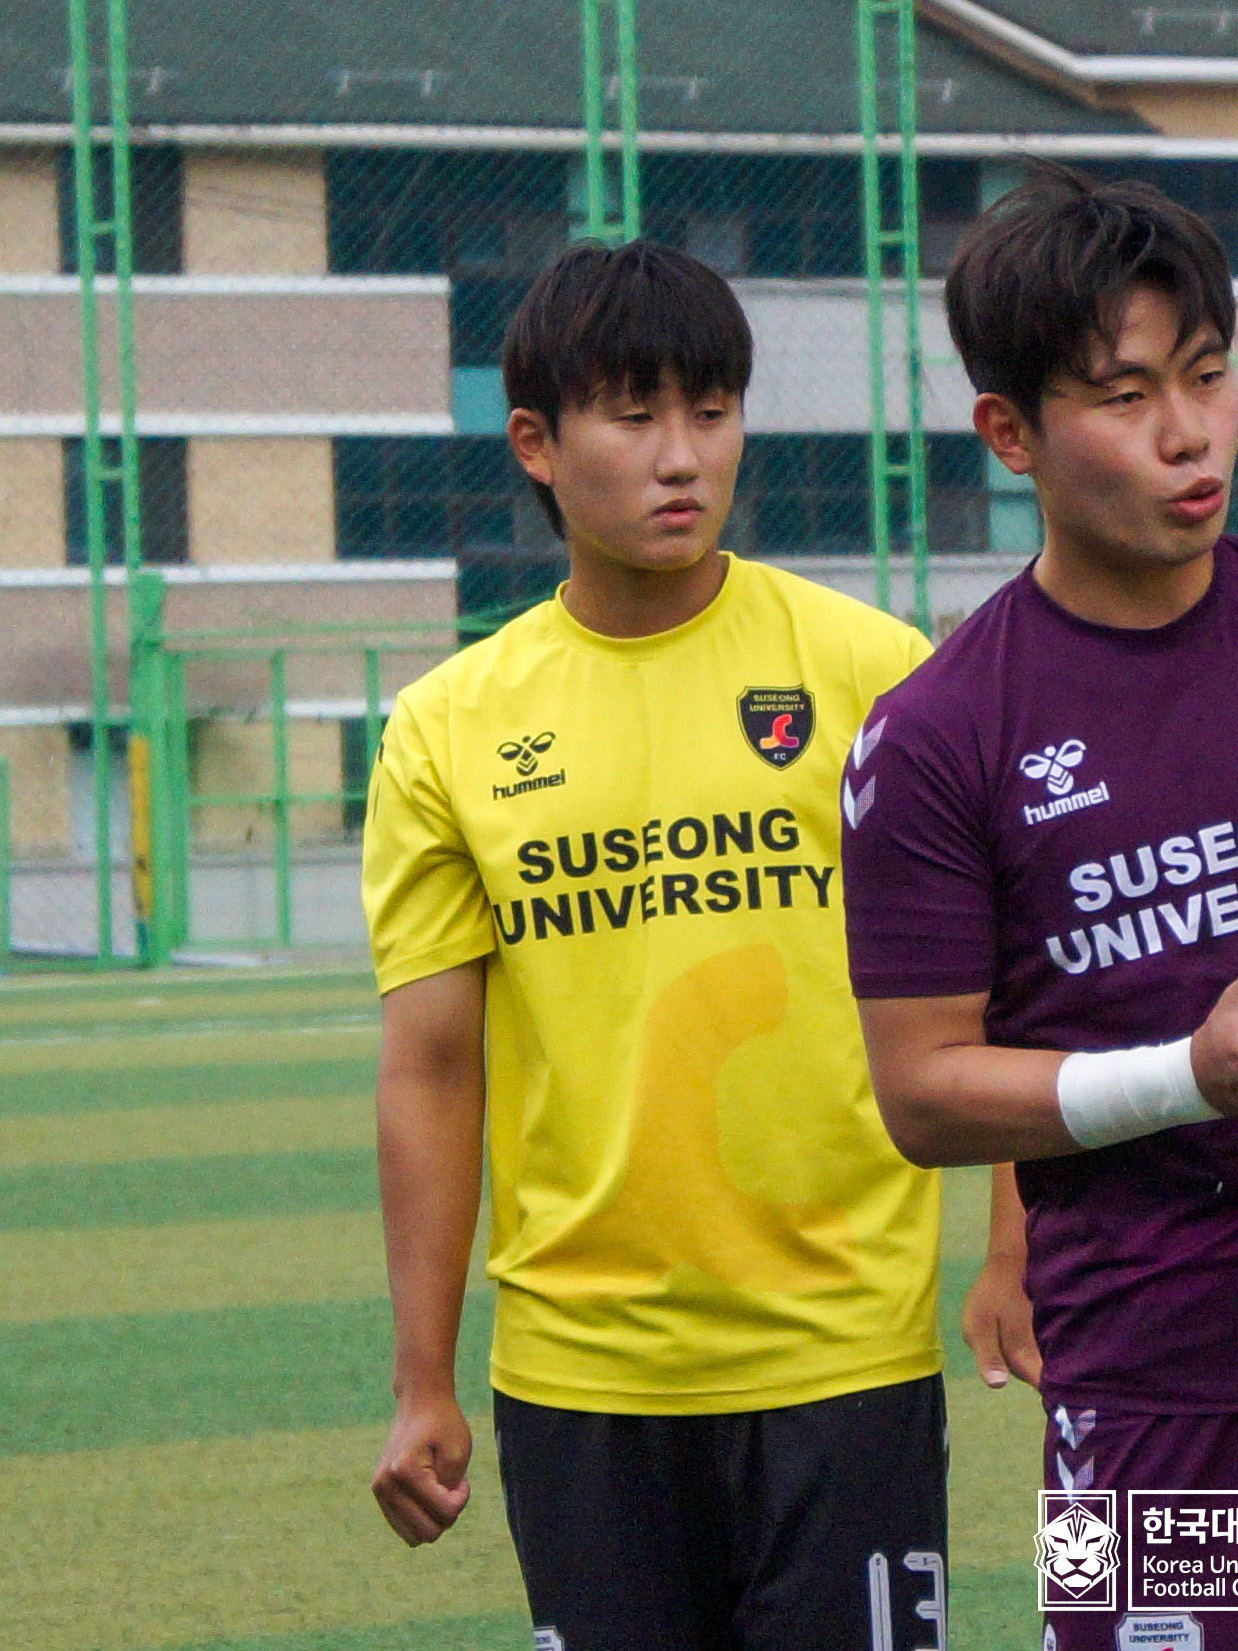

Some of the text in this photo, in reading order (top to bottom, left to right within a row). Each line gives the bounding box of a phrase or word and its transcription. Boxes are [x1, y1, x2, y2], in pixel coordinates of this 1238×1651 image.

[492, 768, 566, 800] hummel
[1023, 781, 1110, 825] hummel
[517, 808, 800, 884] SUSEONG
[492, 865, 836, 945] UNIVERSITY
[868, 1551, 946, 1651] 13
[1128, 1632, 1191, 1644] UNIVERSITY
[1132, 1621, 1184, 1632] SUSEONG
